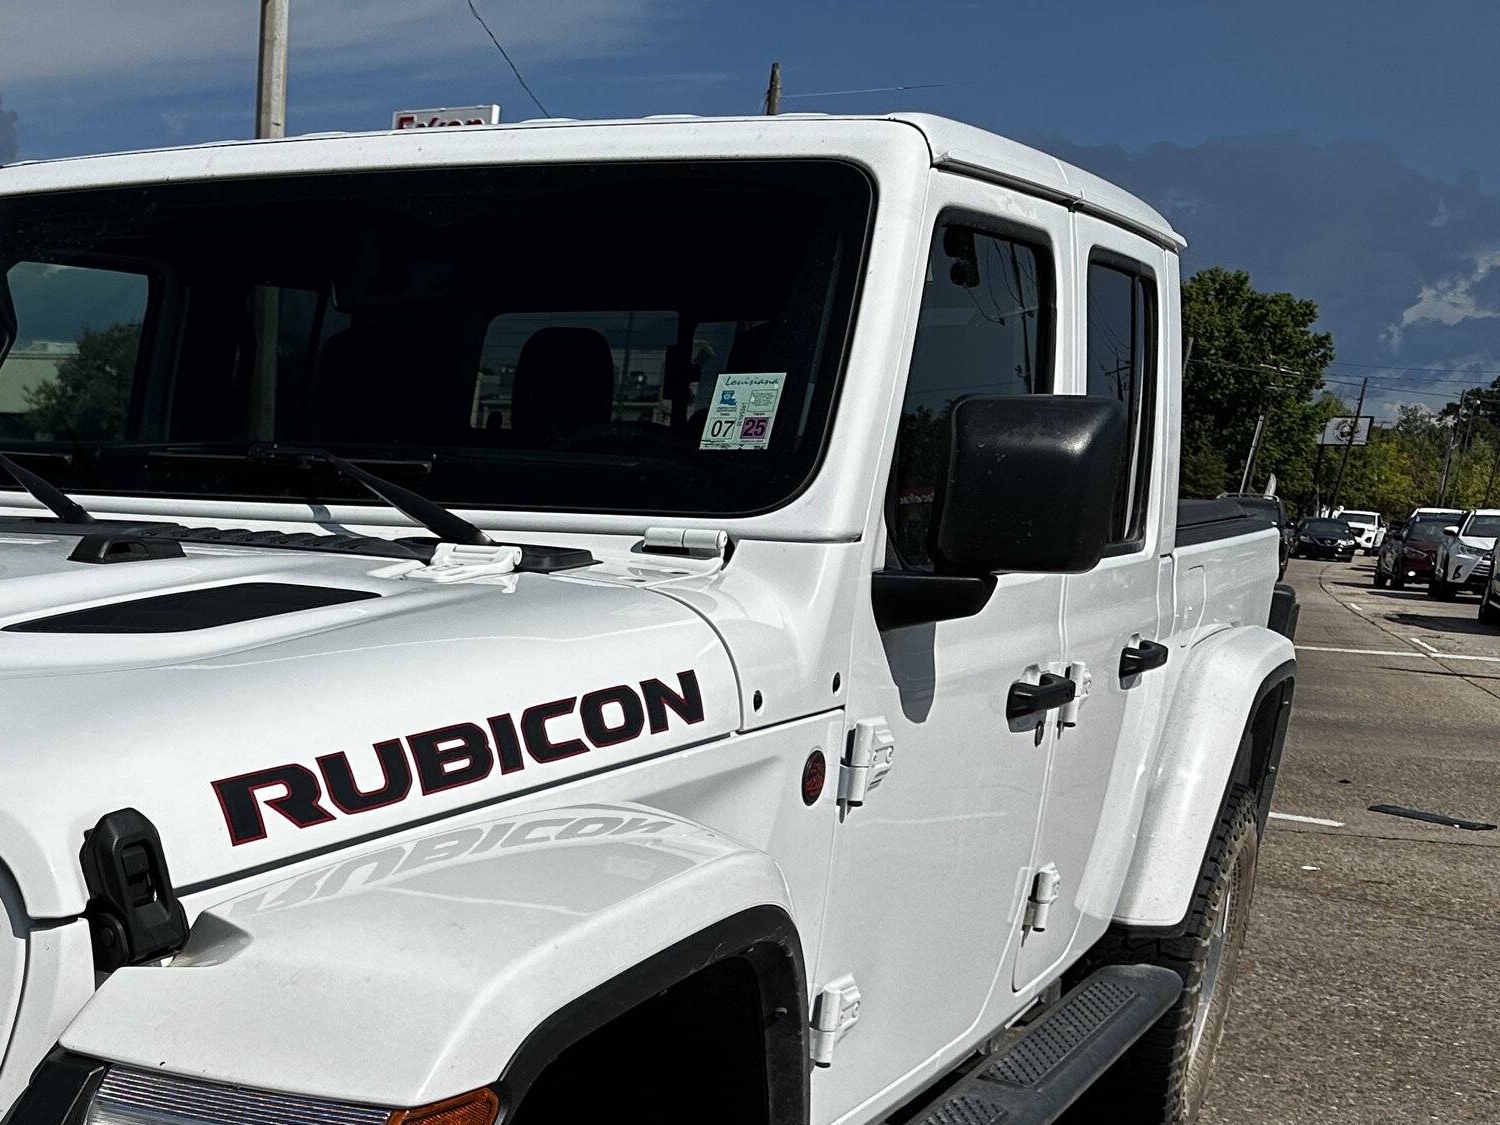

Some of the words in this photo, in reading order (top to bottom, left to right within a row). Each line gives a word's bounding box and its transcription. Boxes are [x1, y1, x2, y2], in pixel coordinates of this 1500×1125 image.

[725, 376, 779, 386] Louisiana
[711, 420, 736, 438] 07
[743, 419, 767, 437] 25
[210, 669, 705, 847] RUBICON
